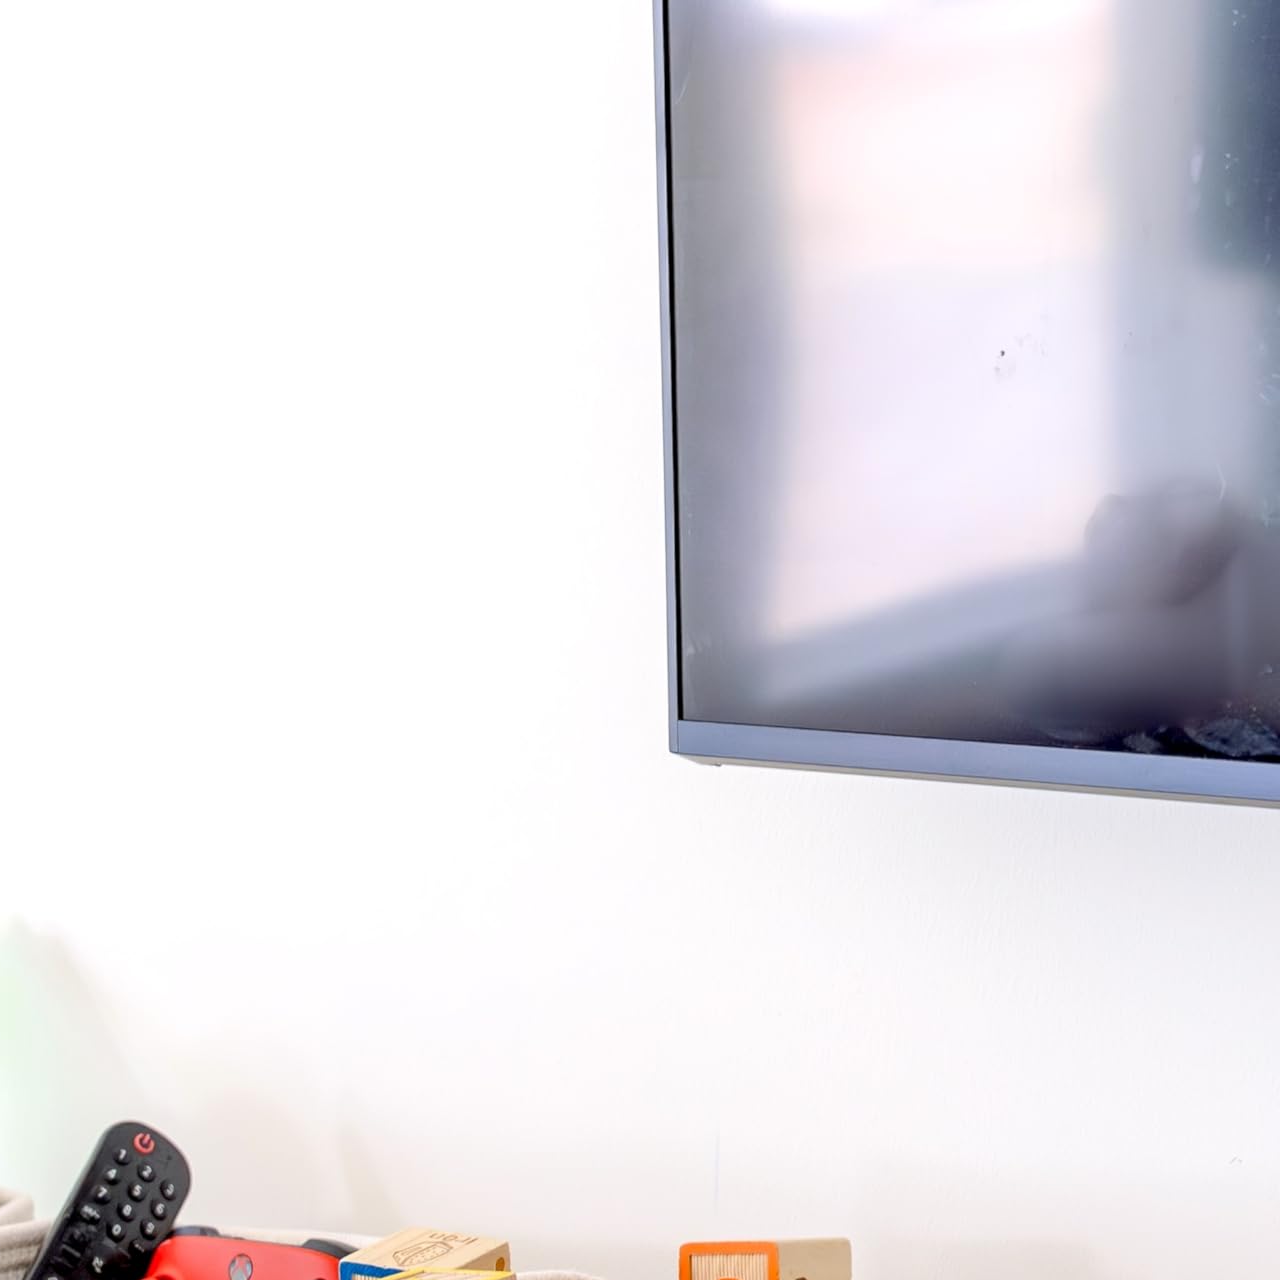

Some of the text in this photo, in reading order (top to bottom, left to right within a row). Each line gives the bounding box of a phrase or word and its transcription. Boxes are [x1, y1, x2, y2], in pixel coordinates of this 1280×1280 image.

[119, 1148, 127, 1160] 1
[107, 1168, 117, 1179] 4
[142, 1165, 153, 1178] 2
[98, 1187, 108, 1198] 7
[132, 1184, 142, 1196] 5
[165, 1183, 175, 1196] 3
[122, 1204, 132, 1216] 8
[155, 1203, 165, 1214] 6
[145, 1222, 155, 1234] 9
